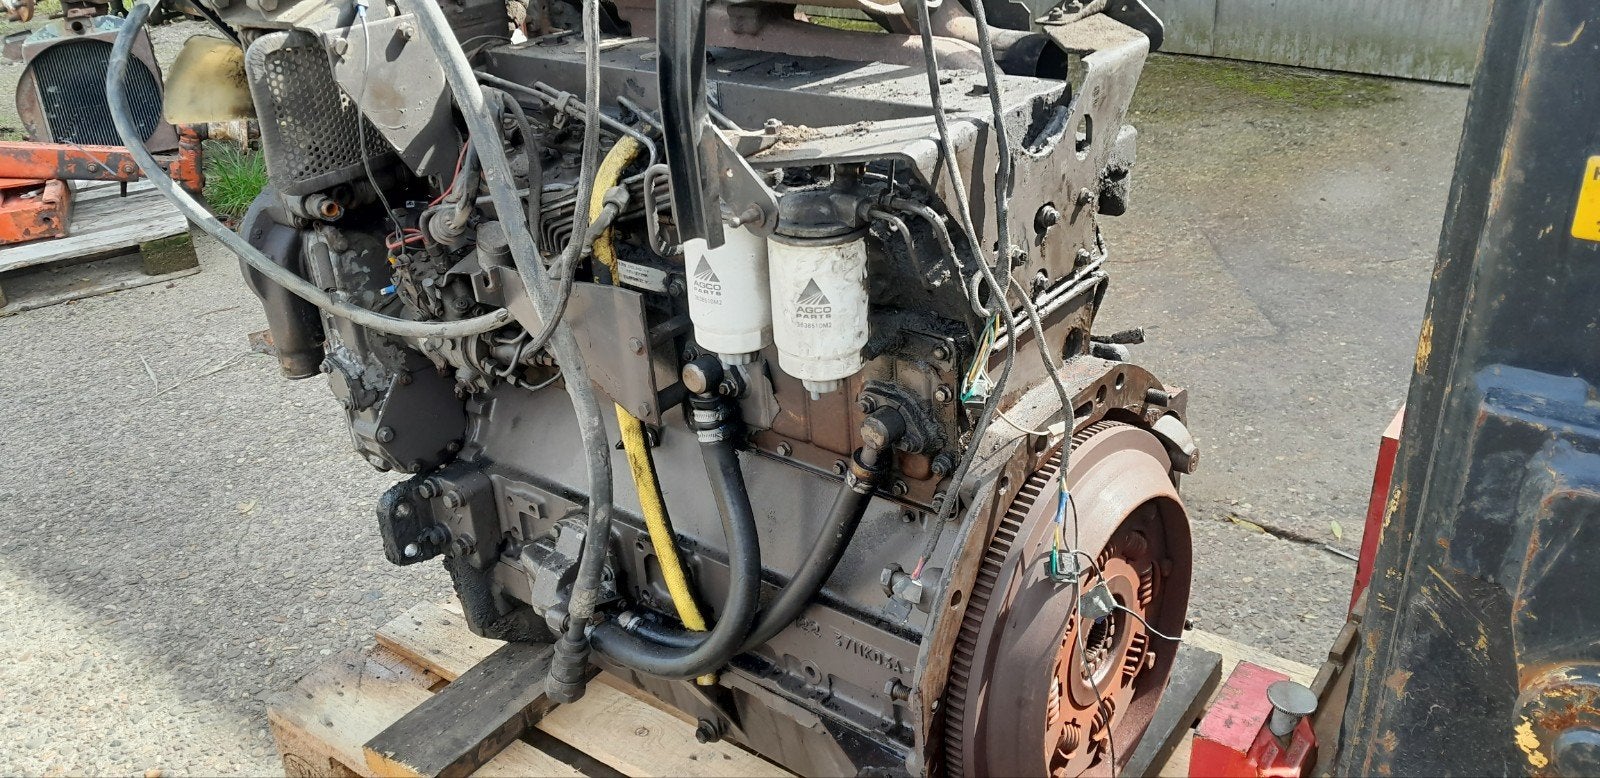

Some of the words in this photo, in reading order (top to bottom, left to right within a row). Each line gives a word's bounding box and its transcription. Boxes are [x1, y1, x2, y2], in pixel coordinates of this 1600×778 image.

[693, 280, 722, 291] AGCO
[693, 287, 722, 296] PARTS
[796, 306, 832, 314] AGCO
